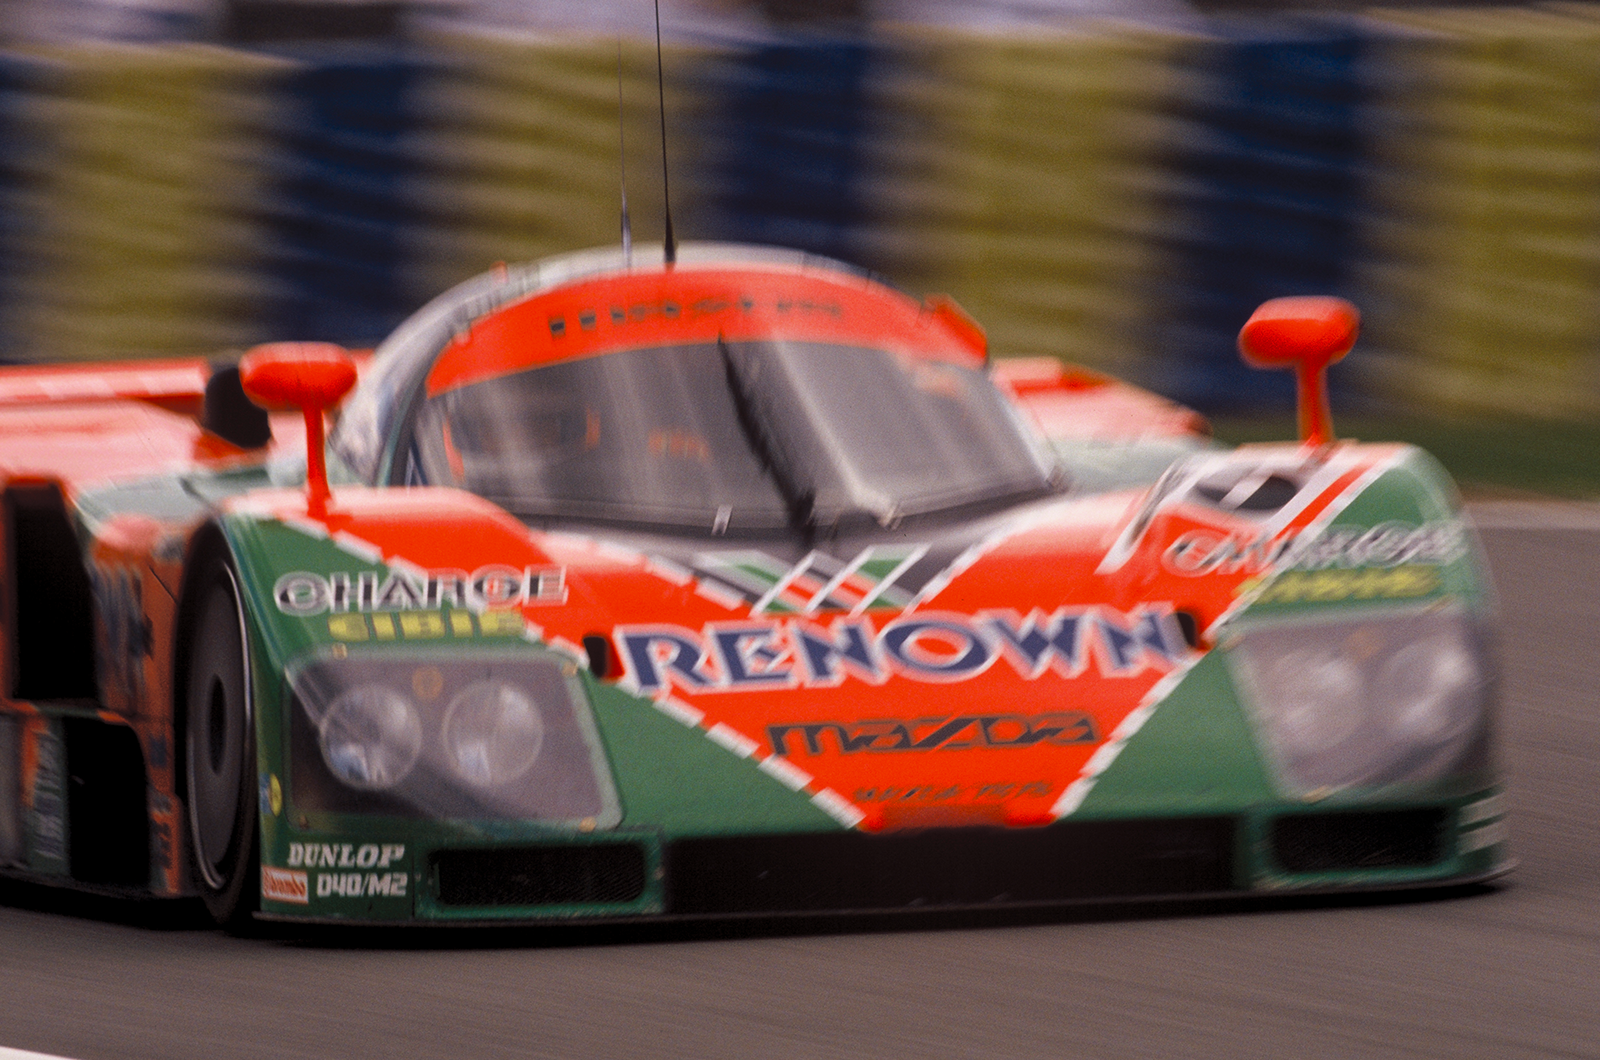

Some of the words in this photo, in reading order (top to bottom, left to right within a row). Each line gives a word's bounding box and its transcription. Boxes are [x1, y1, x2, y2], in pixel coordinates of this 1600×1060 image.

[273, 564, 569, 617] CHARGE
[614, 603, 1187, 695] RENOWN
[287, 842, 405, 868] DUNLOP
[316, 871, 408, 897] D40/M2
